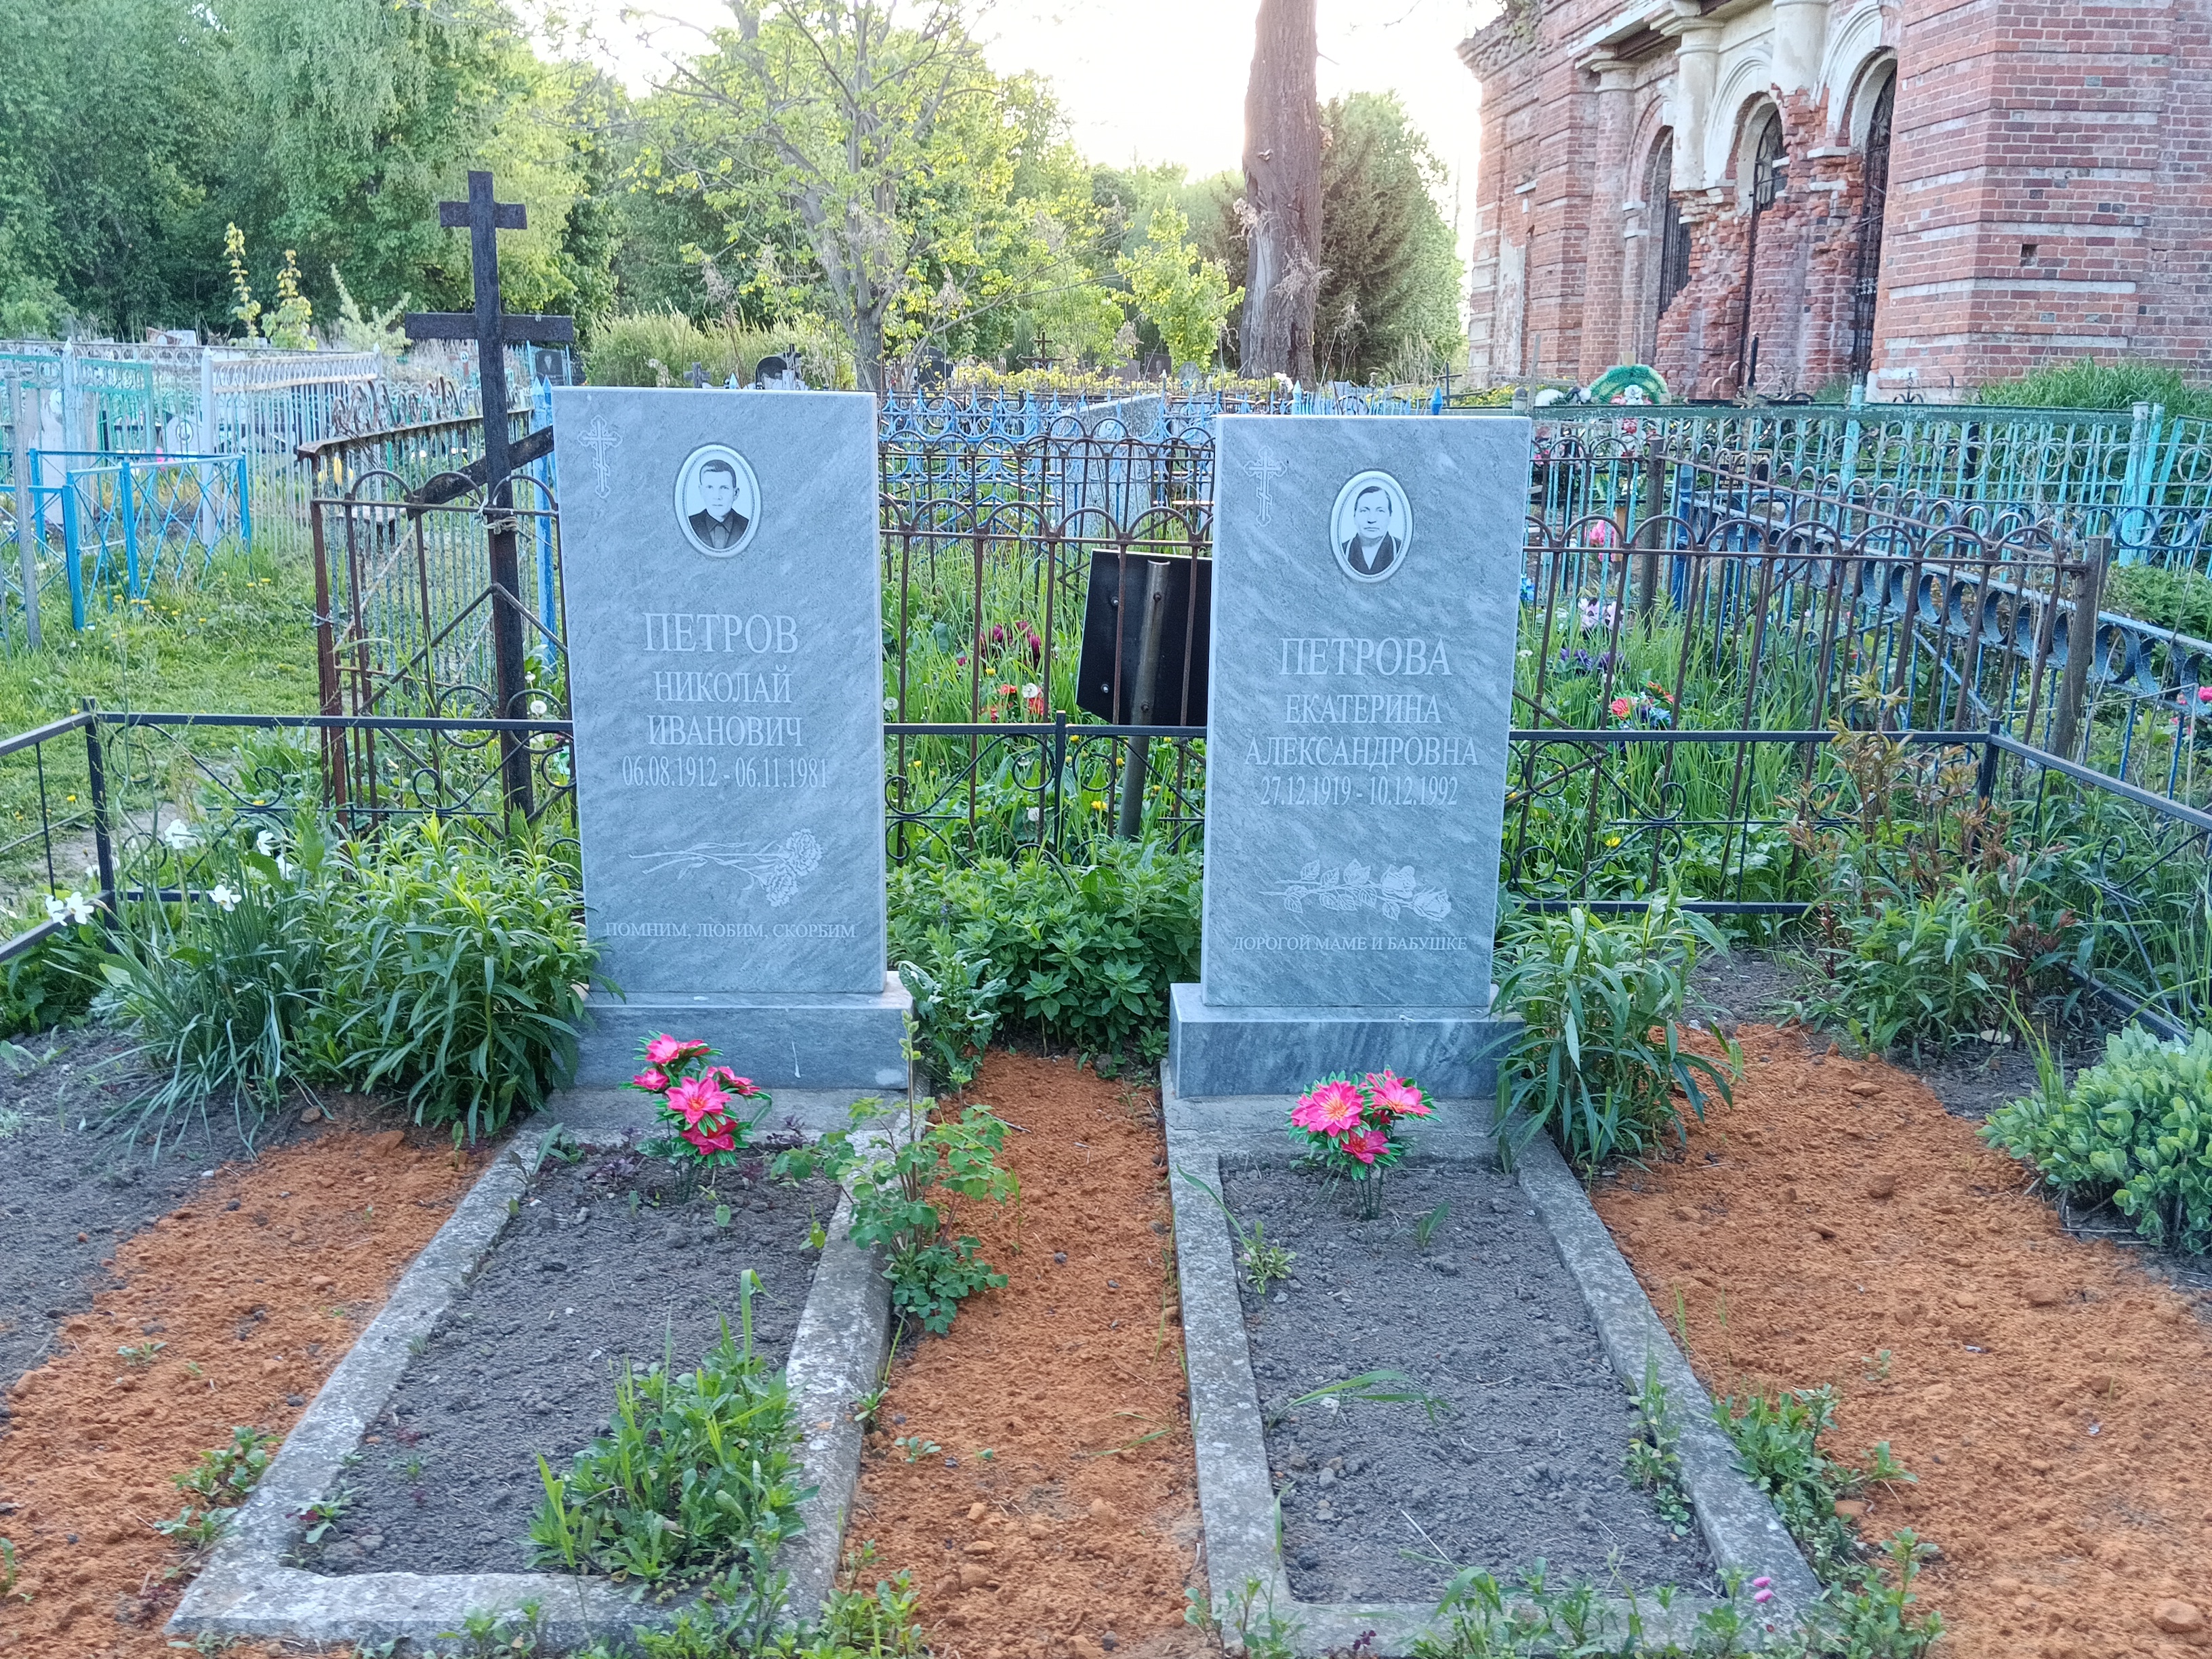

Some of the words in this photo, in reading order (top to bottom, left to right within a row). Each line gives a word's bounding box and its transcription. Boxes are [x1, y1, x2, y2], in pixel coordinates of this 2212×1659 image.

[643, 612, 799, 654] ПЕТРОВ
[1279, 637, 1452, 676] ПЕТРОВА
[653, 664, 793, 703] НИКОЛАЙ
[1284, 693, 1443, 724] ЕКАТЕРИНА
[647, 714, 803, 746] ИВАНОВИЧ
[1244, 737, 1479, 773] АЛЕКСАНДРОВНА
[622, 756, 718, 787] 06.08.1912
[735, 757, 827, 787] 06.11.1981
[1261, 776, 1351, 806] 27.12.1919
[1370, 775, 1458, 806] 10.12.1992
[605, 922, 691, 940] ПОМНИМ,
[695, 923, 769, 940] ЛЮБИМ,
[773, 923, 856, 939] СКОРБИМ
[1232, 934, 1311, 952] ДОРОГОЙ
[1315, 937, 1367, 950] МАМЕ
[1371, 937, 1383, 950] И
[1388, 937, 1467, 951] БАБУШКЕ
